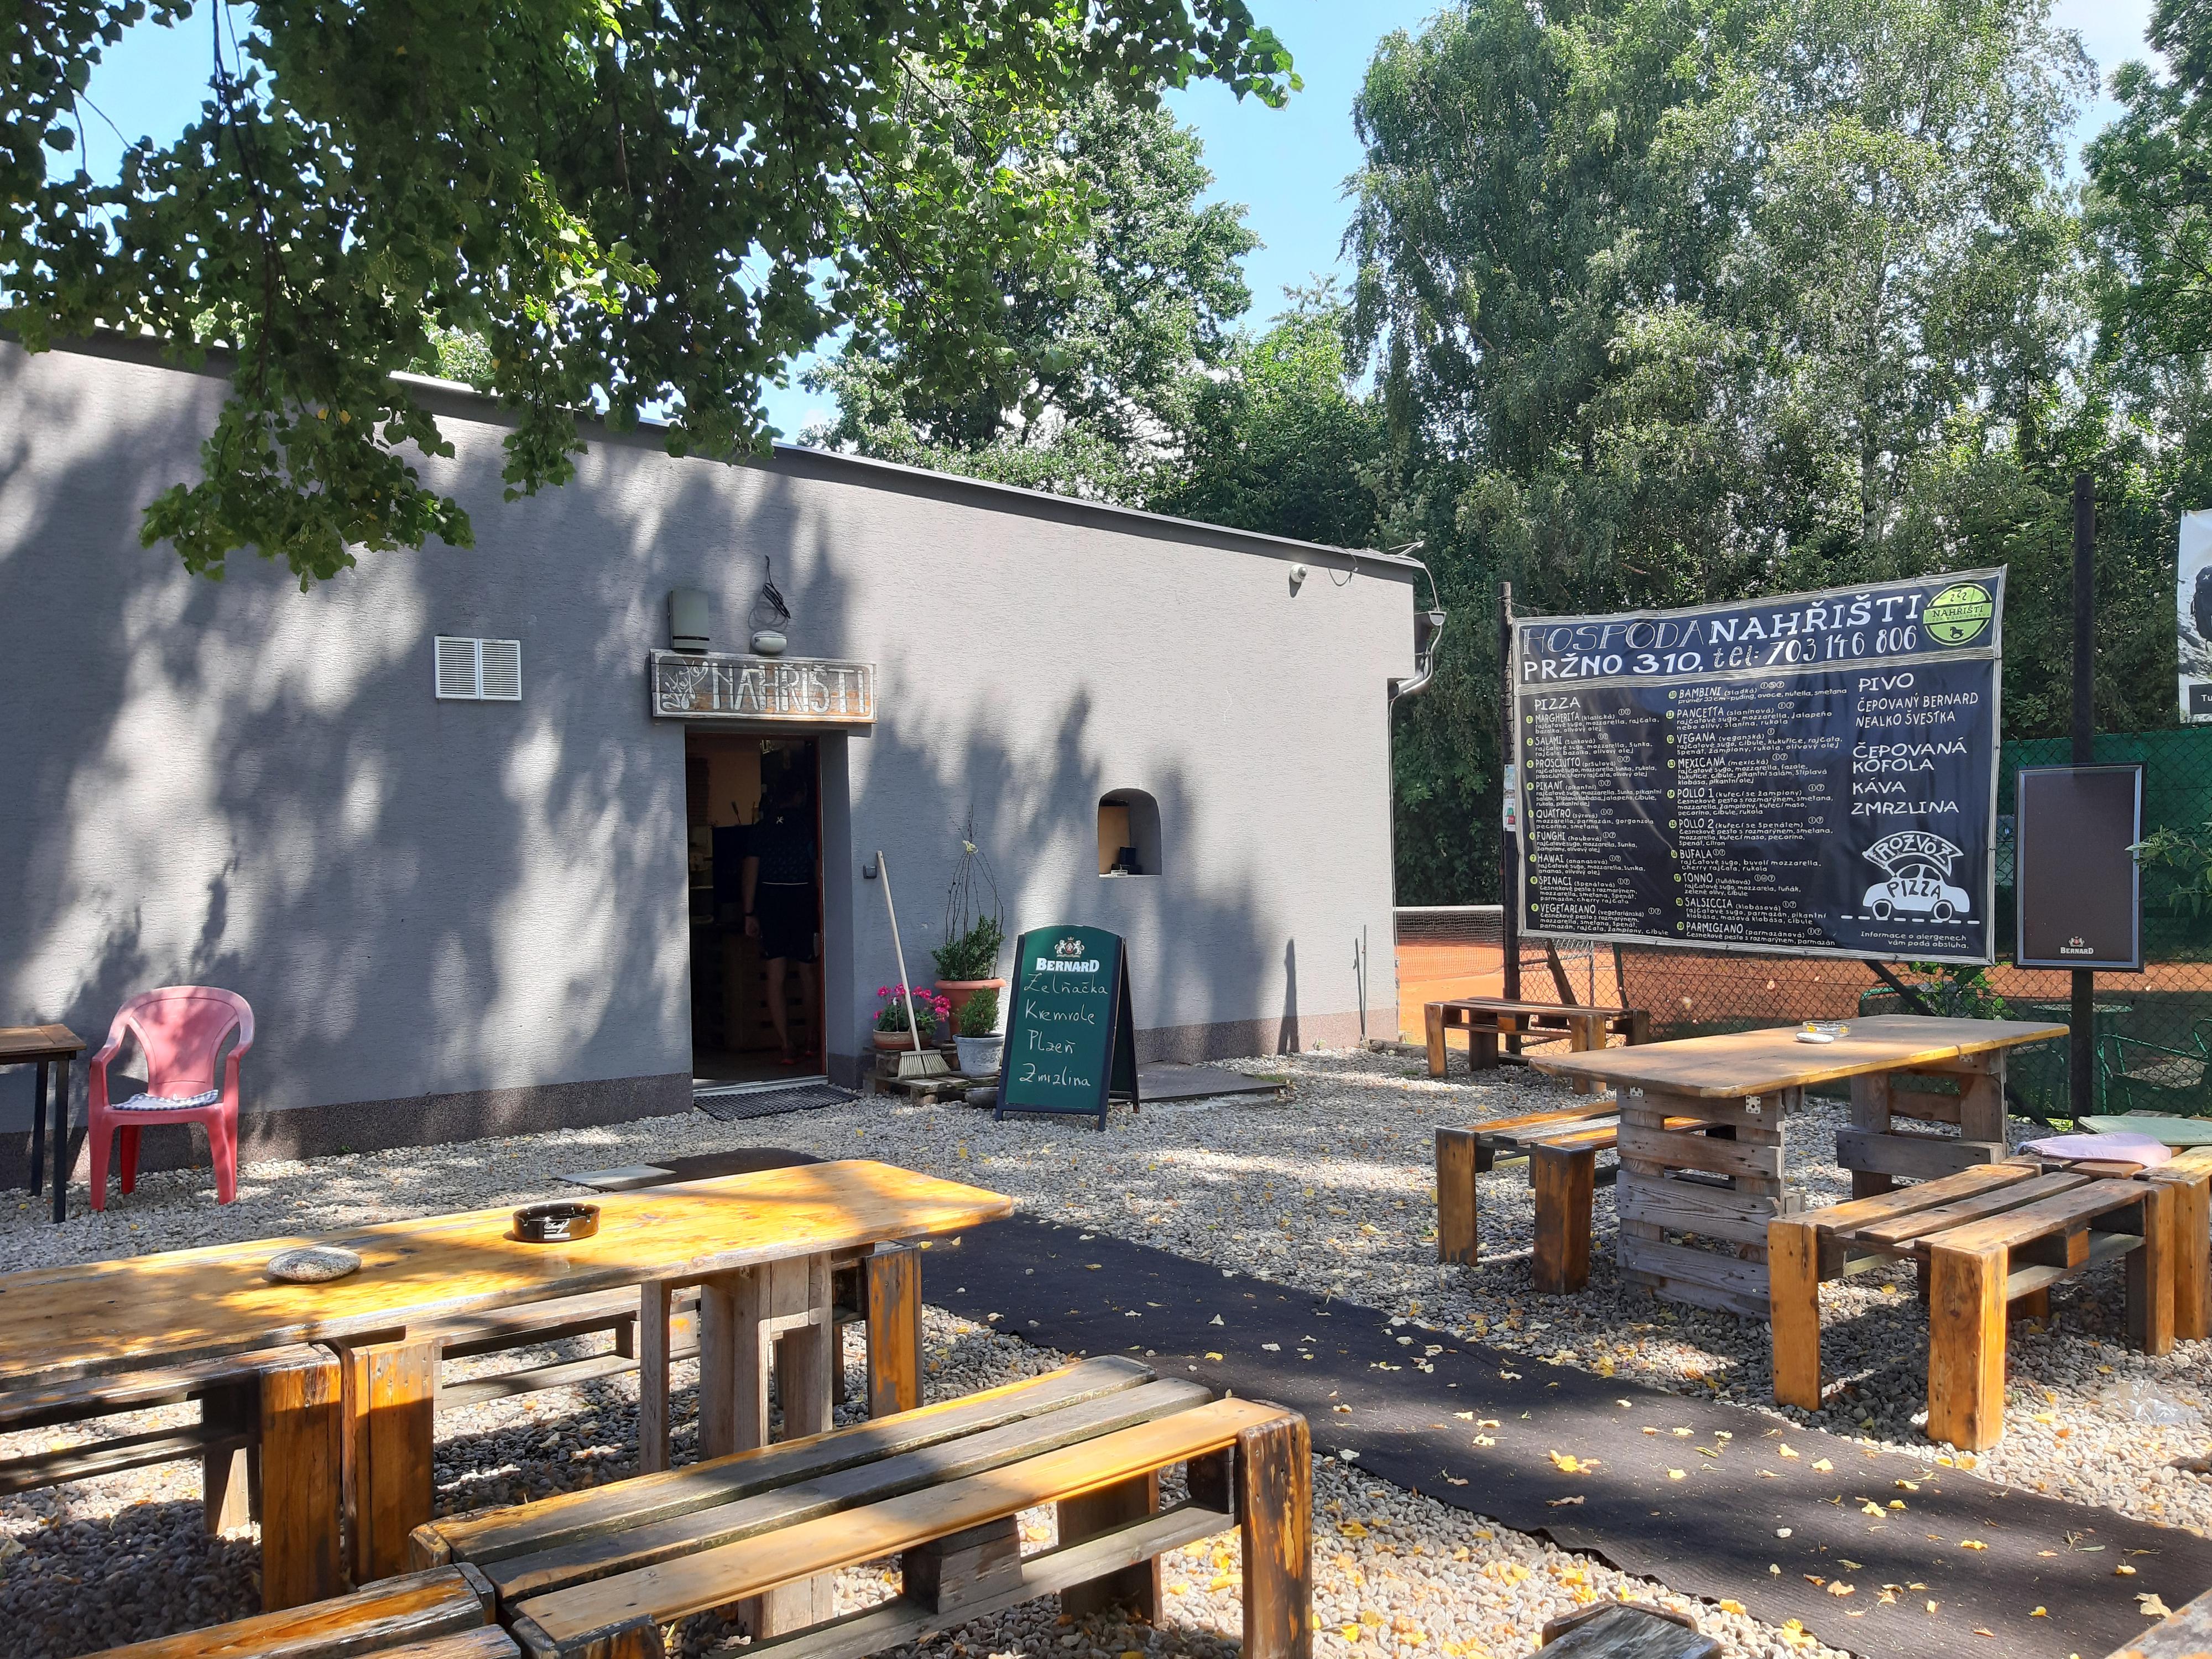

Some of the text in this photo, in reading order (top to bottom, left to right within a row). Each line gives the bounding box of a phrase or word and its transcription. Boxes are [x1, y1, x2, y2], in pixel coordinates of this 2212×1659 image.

[1932, 606, 1983, 617] NAHŘIŠTI
[1522, 595, 1922, 655] HOSPODA NAHŘIŠTI
[1525, 651, 1623, 681] PRŽNO
[1633, 652, 1703, 674] 310,
[1766, 639, 1817, 665] 703
[1825, 635, 1864, 659] 146
[1876, 625, 1917, 654] 806
[712, 662, 864, 713] NAHŘIŠTI
[1858, 672, 1914, 692] PIVO
[1679, 686, 1721, 699] BAMBINI
[1535, 697, 1580, 711] PIZZA
[1858, 692, 1978, 712] ČEPOVANÝ BERNARD
[1536, 712, 1579, 724] MARGHERITA
[1677, 707, 1724, 718] PANCETTA
[1856, 710, 1955, 728] NEALKO ŠVESTKA
[1535, 736, 1562, 745] SALAMI
[1677, 733, 1715, 744] VEGANA
[1853, 737, 1967, 758] ČEPOVANÁ
[1536, 757, 1580, 768] PROSCIUTTO
[1678, 757, 1725, 769] MEXICANA
[1853, 758, 1934, 774] KOFOLA
[1536, 781, 1563, 790] PIKANT
[1853, 778, 1906, 795] KÁVA
[1677, 788, 1705, 798] POLLO
[1708, 789, 1714, 798] 1
[1536, 808, 1571, 818] QUATTRO
[1851, 801, 1959, 816] ZMRZLINA
[1679, 818, 1704, 828] POLLO
[1708, 819, 1713, 828] 2
[1537, 831, 1566, 841] FUNGHI
[1679, 849, 1713, 858] BUFALA
[1875, 835, 1949, 864] ROZVOZ
[1538, 854, 1564, 863] HAWAI
[1539, 876, 1572, 885] SPINACI
[1683, 873, 1713, 883] TONNO
[1887, 880, 1940, 900] PIZZA
[1541, 904, 1595, 913] VEGETARIANO
[1685, 898, 1732, 907] SALSICCIA
[1687, 922, 1743, 933] PARMIGIANO
[1798, 938, 1835, 946] parmazán
[1036, 958, 1099, 972] BERNARD
[1025, 999, 1095, 1025] Kremrole
[1028, 1029, 1076, 1053] Plzeň
